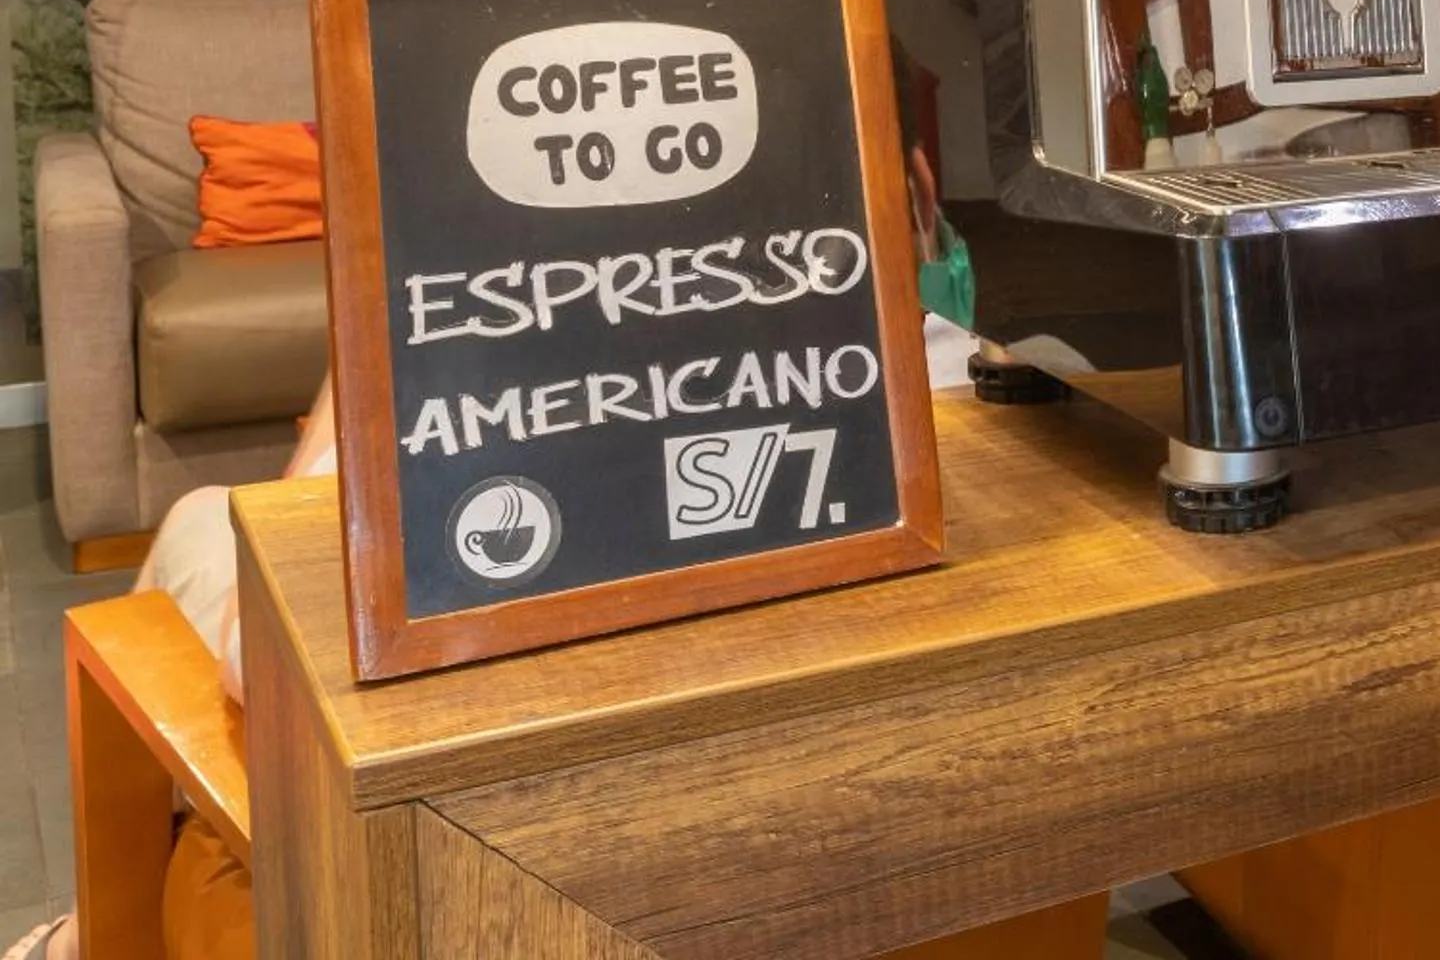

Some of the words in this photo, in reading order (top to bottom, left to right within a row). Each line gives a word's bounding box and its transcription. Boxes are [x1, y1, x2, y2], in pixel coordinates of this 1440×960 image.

[498, 53, 738, 117] COFFEE
[534, 131, 615, 185] TO
[645, 122, 723, 174] GO
[406, 228, 868, 346] ESPRESSO
[400, 344, 878, 456] AMERICANO
